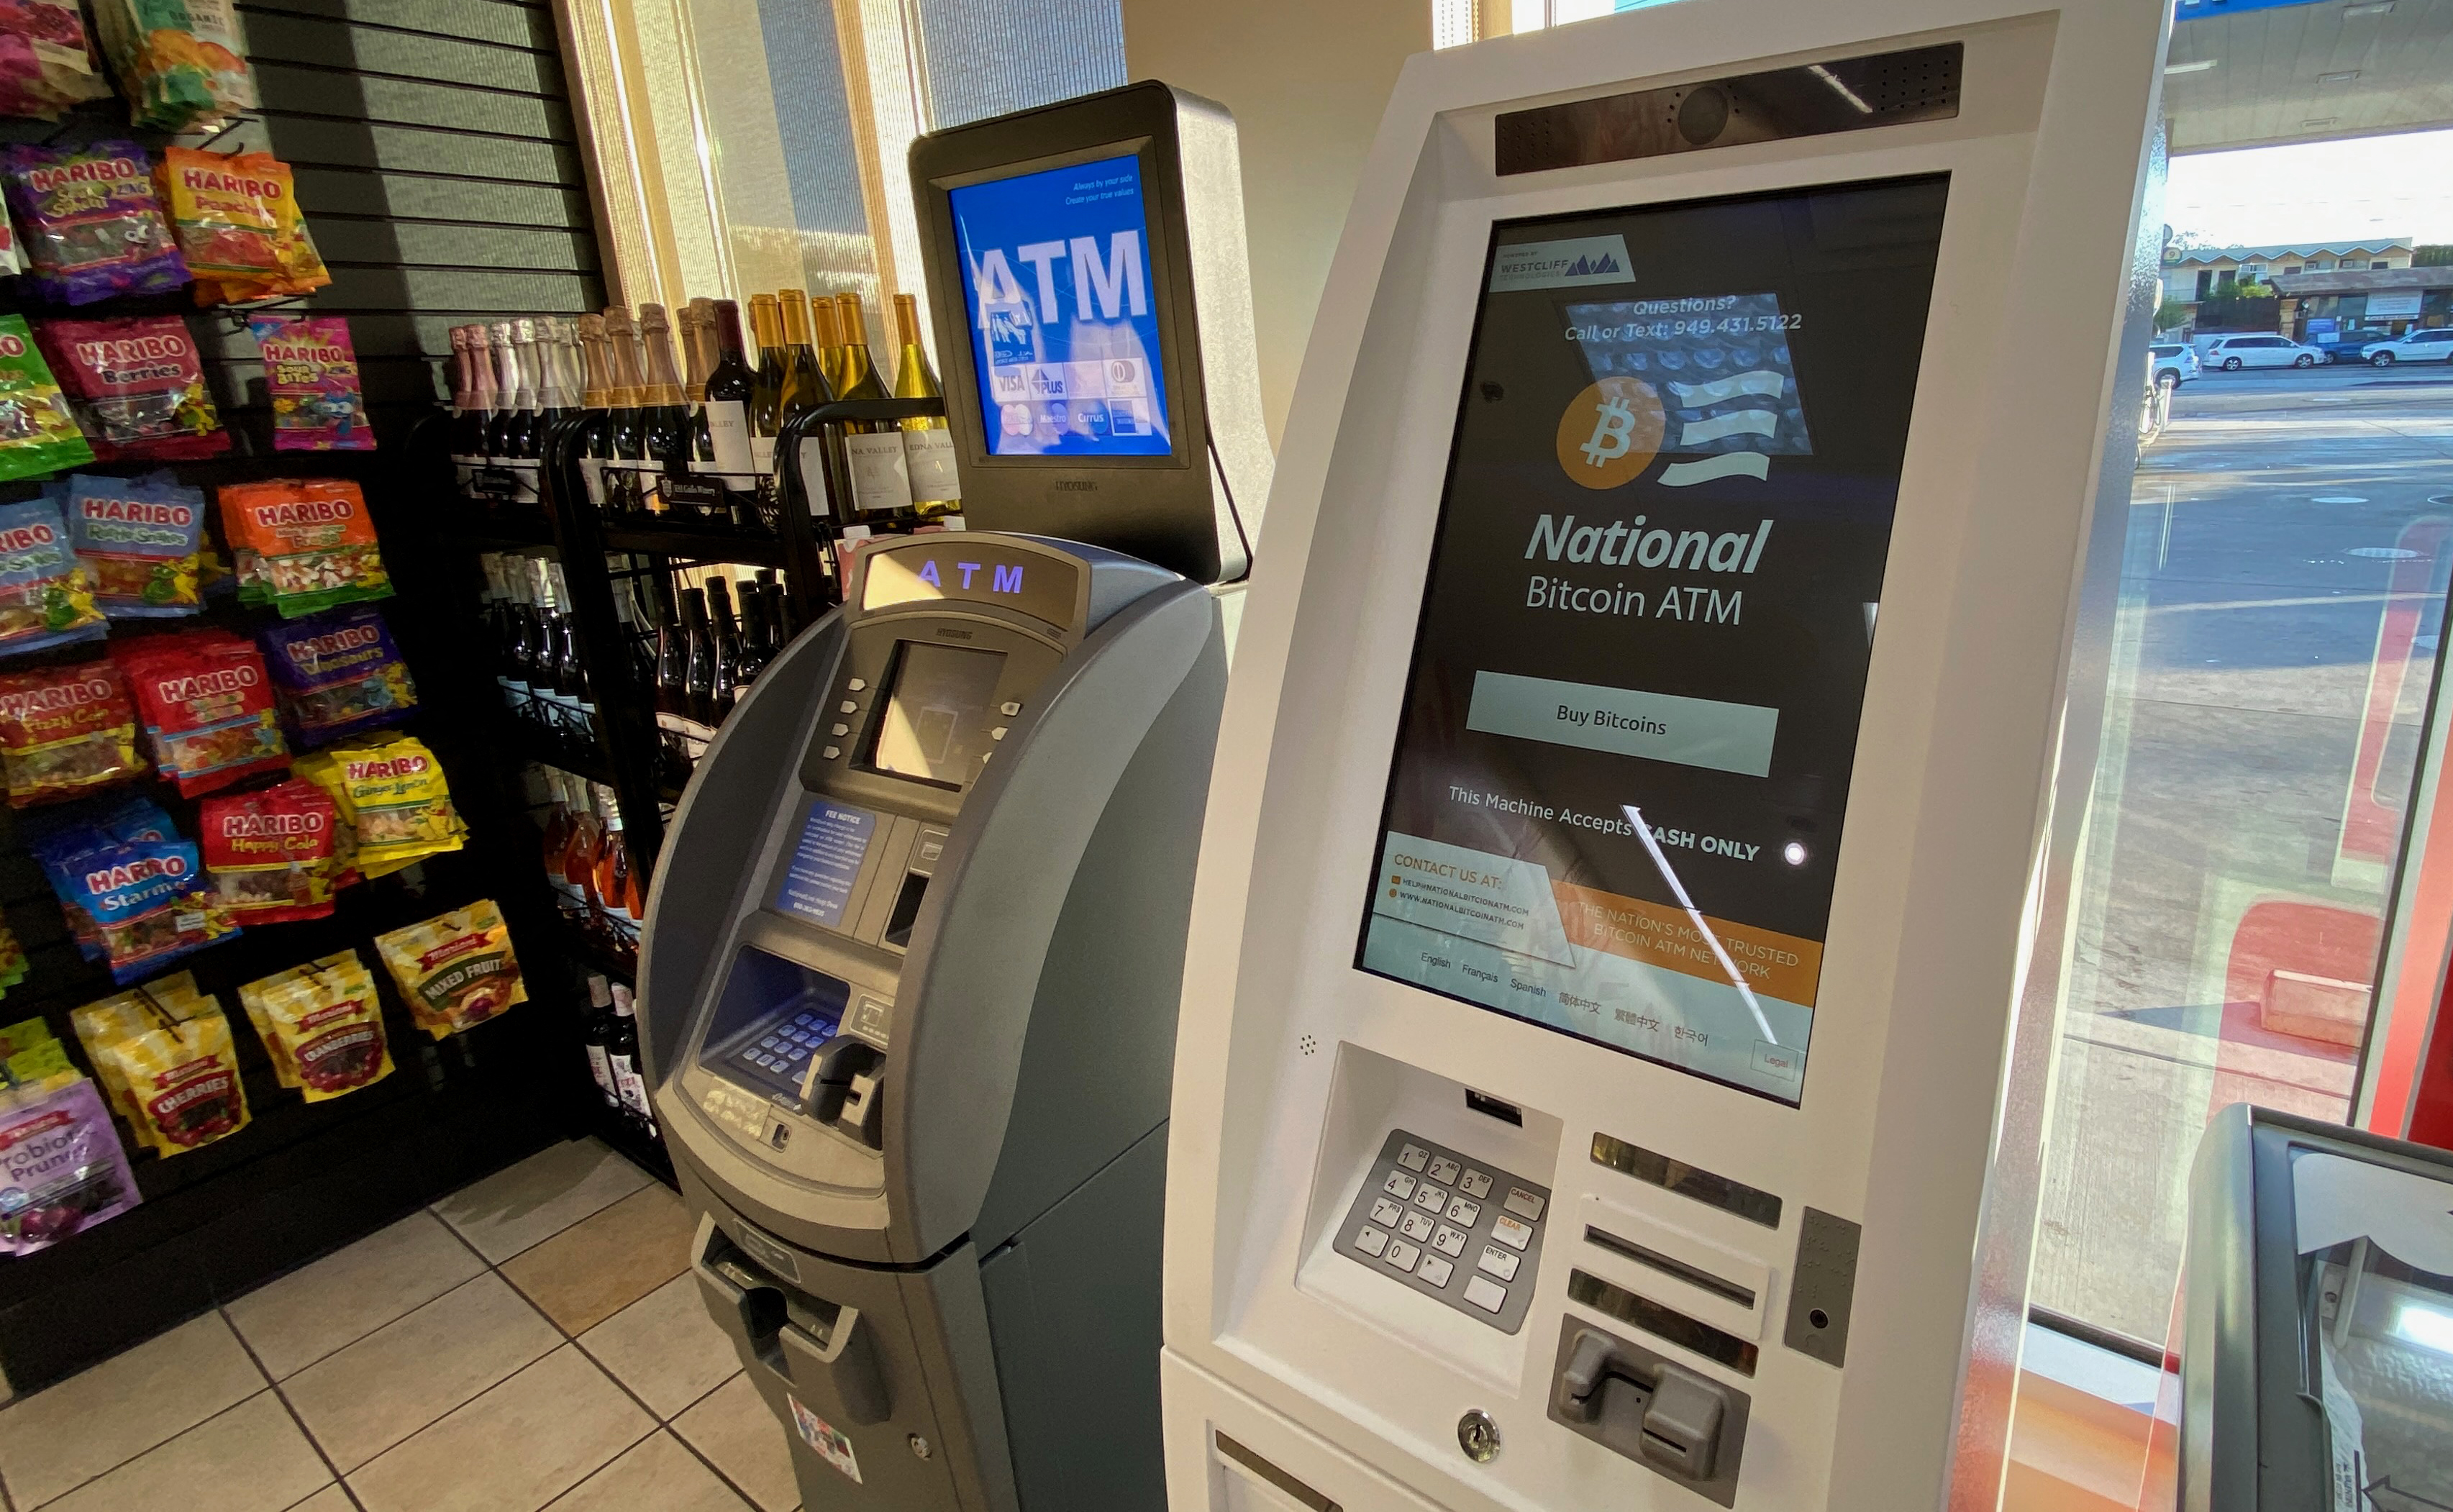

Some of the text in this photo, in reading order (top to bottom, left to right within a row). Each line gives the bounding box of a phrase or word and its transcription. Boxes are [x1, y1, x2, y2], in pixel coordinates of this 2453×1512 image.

[32, 157, 136, 190] HARIBO
[183, 168, 282, 199] HARIBO
[1501, 260, 1569, 273] WESTCLIFF
[978, 230, 1147, 329] ATM
[1633, 296, 1737, 316] Questions?
[1565, 314, 1803, 342] Call or Text: 949.431.5122
[76, 335, 185, 365] HARIBO
[264, 345, 344, 363] HARIBO
[103, 363, 182, 384] Berries
[999, 374, 1025, 392] VISA
[1041, 380, 1064, 395] PLUS
[1039, 414, 1067, 423] Maestro
[1078, 412, 1104, 423] Cirrus
[865, 446, 898, 455] VALLEY
[934, 441, 954, 450] VALL
[83, 497, 194, 528] HARIBO
[255, 499, 354, 527] HARIBO
[1524, 514, 1774, 574] National
[1526, 575, 1743, 626] Bitcoin ATM
[937, 627, 973, 640] HYOSUNG
[286, 625, 381, 662] HARIBO
[160, 665, 259, 703] HARIBO
[0, 680, 112, 719] HARIBO
[1556, 704, 1667, 735] Buy Bitcoins
[347, 754, 429, 780] HARIBO
[223, 812, 322, 837] HARIBO
[837, 813, 862, 825] NOTICE
[1449, 785, 1761, 862] This Machine Accepts ASH ONLY
[284, 836, 318, 850] Cola
[1393, 853, 1503, 890] CONTACT US AT:
[1399, 891, 1524, 930] WWW.NATIONALBITCOINATM.COM
[1577, 901, 1603, 918] THE
[1606, 909, 1674, 936] NATION'S
[1726, 937, 1800, 967] TRUSTED
[1593, 923, 1771, 980] BITCOIN ATM NETORK
[424, 958, 501, 1000] MIXED FRUIT
[1421, 952, 1547, 998] English Français Spanish
[1558, 991, 1601, 1015] 简体中文
[1674, 1025, 1709, 1047] 한국어
[1763, 1053, 1789, 1069] Legal
[158, 1076, 229, 1113] CHERRIES
[1403, 1152, 1410, 1163] 1
[1418, 1150, 1429, 1159] QZ
[1430, 1164, 1441, 1176] 2
[1446, 1162, 1460, 1172] ABC
[1388, 1178, 1397, 1190] 4
[1404, 1176, 1415, 1185] GHI
[1463, 1176, 1473, 1189] 3
[1478, 1174, 1491, 1184] DEF
[1417, 1190, 1429, 1203] 5
[1434, 1189, 1446, 1200] JKL
[1511, 1188, 1536, 1203] CANCEL
[1374, 1205, 1384, 1217] 7
[1388, 1203, 1401, 1213] PRS
[1450, 1205, 1460, 1217] 6
[1463, 1202, 1478, 1213] MNO
[1403, 1219, 1414, 1231] 8
[1419, 1216, 1433, 1227] TUV
[1498, 1217, 1521, 1231] CLEAR
[1437, 1233, 1447, 1246] 9
[1450, 1230, 1465, 1242] WXY
[1391, 1244, 1401, 1258] 0
[1485, 1247, 1508, 1261] ENTER
